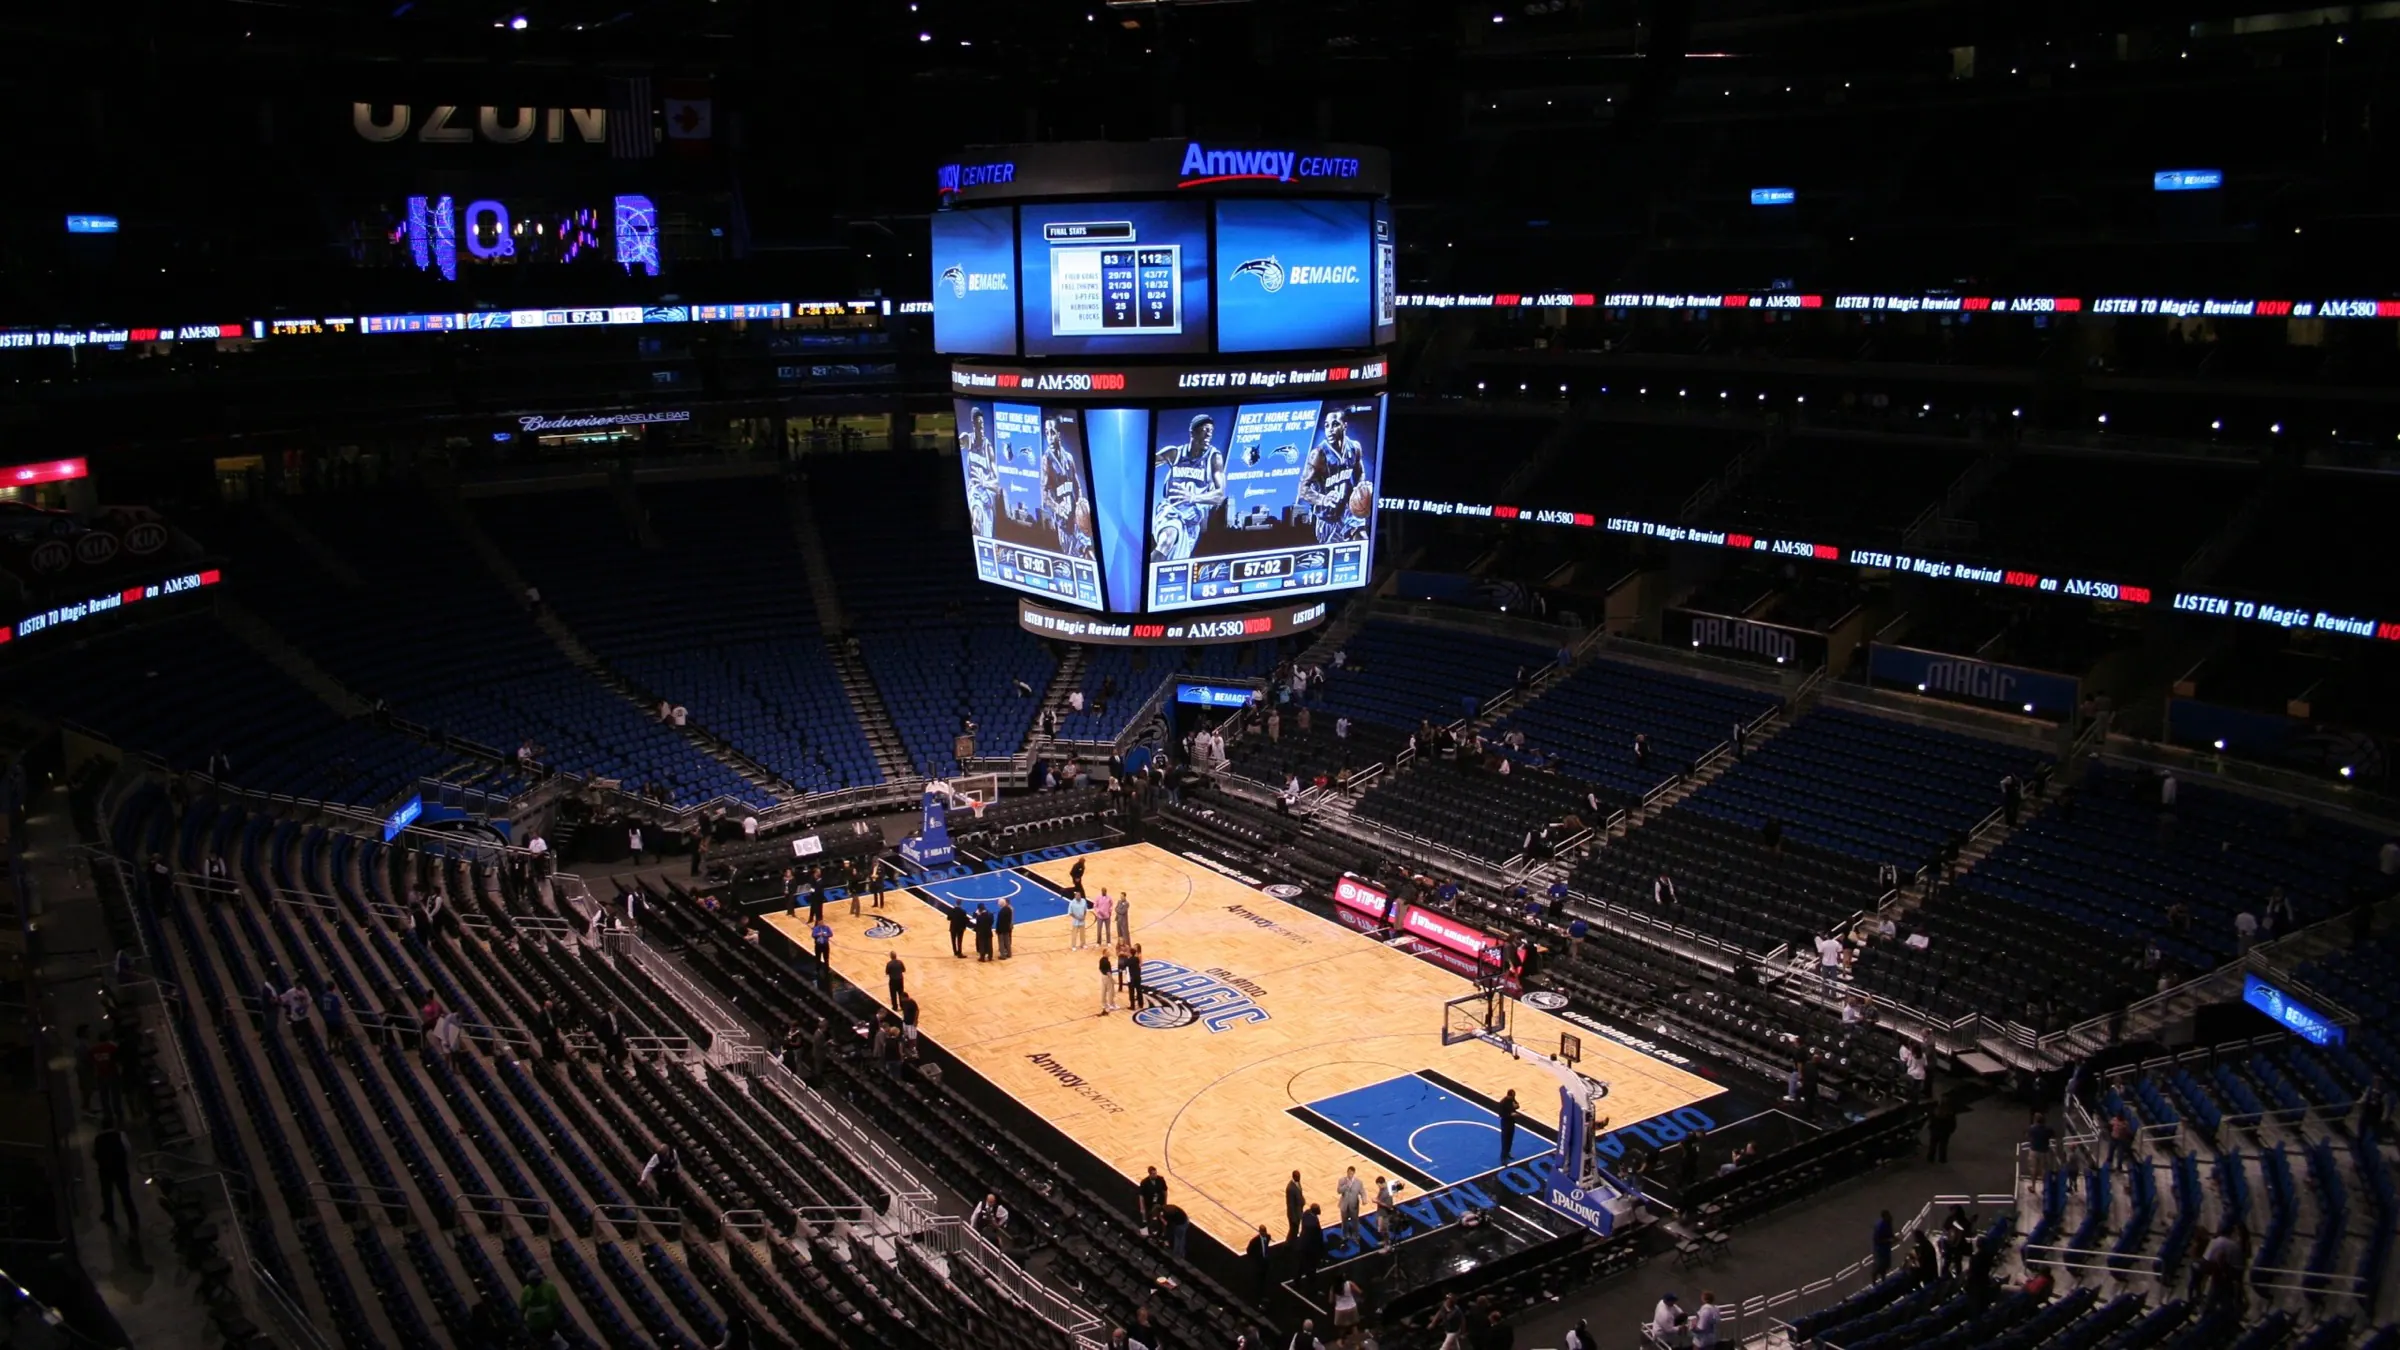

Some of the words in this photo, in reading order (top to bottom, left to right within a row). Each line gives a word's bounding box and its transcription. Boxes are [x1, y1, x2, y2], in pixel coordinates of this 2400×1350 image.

[1181, 143, 1294, 183] Amway
[1300, 157, 1359, 178] CENTER
[962, 164, 1014, 185] CENTER
[1050, 228, 1067, 236] FINAL
[1069, 227, 1087, 235] STATS
[1104, 255, 1118, 265] 83
[1141, 254, 1162, 264] 112
[1290, 266, 1360, 285] BEMAGIC.
[1411, 295, 1423, 305] TO
[1425, 295, 1455, 307] Magic
[1457, 295, 1493, 306] Rewind
[1495, 295, 1520, 305] NOW
[1521, 296, 1533, 306] on
[1605, 295, 1639, 306] LISTEN
[1641, 295, 1654, 306] TO
[1655, 296, 1685, 308] Magic
[1686, 295, 1721, 306] Rewind
[1723, 296, 1748, 306] NOW
[1749, 297, 1762, 307] on
[1836, 297, 1869, 308] LISTEN
[1872, 297, 1885, 308] TO
[1887, 297, 1919, 312] Magic
[1922, 298, 1960, 310] Rewind
[1963, 298, 1991, 310] NOW
[1991, 300, 2005, 310] on
[2093, 300, 2136, 313] LISTEN
[2141, 300, 2156, 313] TO
[2160, 300, 2199, 317] Magic
[2203, 301, 2254, 315] Rewind
[2256, 302, 2292, 316] NOW
[2293, 303, 2311, 315] on
[618, 311, 637, 321] 112
[1118, 312, 1124, 320] 3
[0, 334, 33, 347] ISTEN
[36, 333, 50, 346] TO
[53, 332, 86, 347] Magic
[89, 330, 128, 343] Rewind
[160, 330, 174, 340] on
[971, 372, 996, 387] Rewind
[997, 374, 1019, 387] NOW
[1021, 376, 1034, 388] on
[1091, 374, 1125, 390] WDBO
[1179, 373, 1227, 387] LISTEN
[1231, 372, 1246, 386] TO
[1250, 371, 1286, 387] Magic
[1290, 368, 1327, 384] Rewind
[1329, 367, 1349, 381] NOW
[1350, 368, 1359, 379] on
[518, 415, 615, 431] Budweiser
[1240, 413, 1264, 424] NEXT
[1265, 411, 1289, 423] HOME
[1291, 410, 1316, 421] GAME
[1378, 498, 1404, 510] STEN
[1408, 499, 1420, 510] TO
[1423, 501, 1453, 515] Magic
[1456, 503, 1492, 517] Rewind
[1494, 505, 1519, 518] NOW
[1519, 510, 1532, 520] on
[1607, 518, 1639, 534] LISTEN
[1642, 522, 1654, 534] TO
[1657, 525, 1686, 540] Magic
[1688, 529, 1725, 545] Rewind
[1727, 533, 1754, 549] NOW
[1754, 539, 1767, 550] on
[1023, 556, 1046, 573] 57:02
[1244, 560, 1281, 577] 57:02
[1851, 550, 1891, 568] LISTEN
[1895, 556, 1910, 570] TO
[1913, 559, 1951, 578] Magic
[1955, 564, 2001, 583] Rewind
[2005, 570, 2038, 588] NOW
[2040, 577, 2057, 590] on
[1169, 572, 1176, 582] 3
[1302, 572, 1323, 585] 112
[1059, 581, 1073, 595] 112
[1202, 584, 1217, 597] 83
[1223, 586, 1239, 595] WAS
[19, 613, 46, 636] LISTEN
[49, 610, 59, 625] TO
[61, 603, 87, 622] Magic
[89, 593, 121, 613] Rewind
[146, 585, 159, 598] on
[1293, 608, 1314, 625] LISTEN
[2173, 593, 2228, 614] LISTEN
[2234, 601, 2254, 618] TO
[2258, 605, 2310, 626] Magic
[2314, 612, 2374, 637] Rewind
[2376, 622, 2400, 641] NO
[1024, 611, 1043, 628] LISTEN
[1044, 614, 1055, 629] TO
[1056, 617, 1085, 635] Magic
[1087, 622, 1129, 637] Rewind
[1133, 624, 1164, 638] NOW
[1167, 626, 1182, 638] on
[1691, 617, 1796, 662] ORLANDO
[1926, 659, 2017, 701] MAGIC
[943, 846, 951, 855] TV
[983, 841, 1101, 870] MAGIC
[1222, 904, 1274, 928] Amway
[1416, 917, 1443, 934] Where
[1204, 967, 1268, 998] ORLANDO
[1140, 959, 1272, 1034] MAGIC
[1025, 1052, 1088, 1088] Amway
[1074, 1086, 1124, 1114] CENTER
[1551, 1188, 1601, 1228] SPALDING
